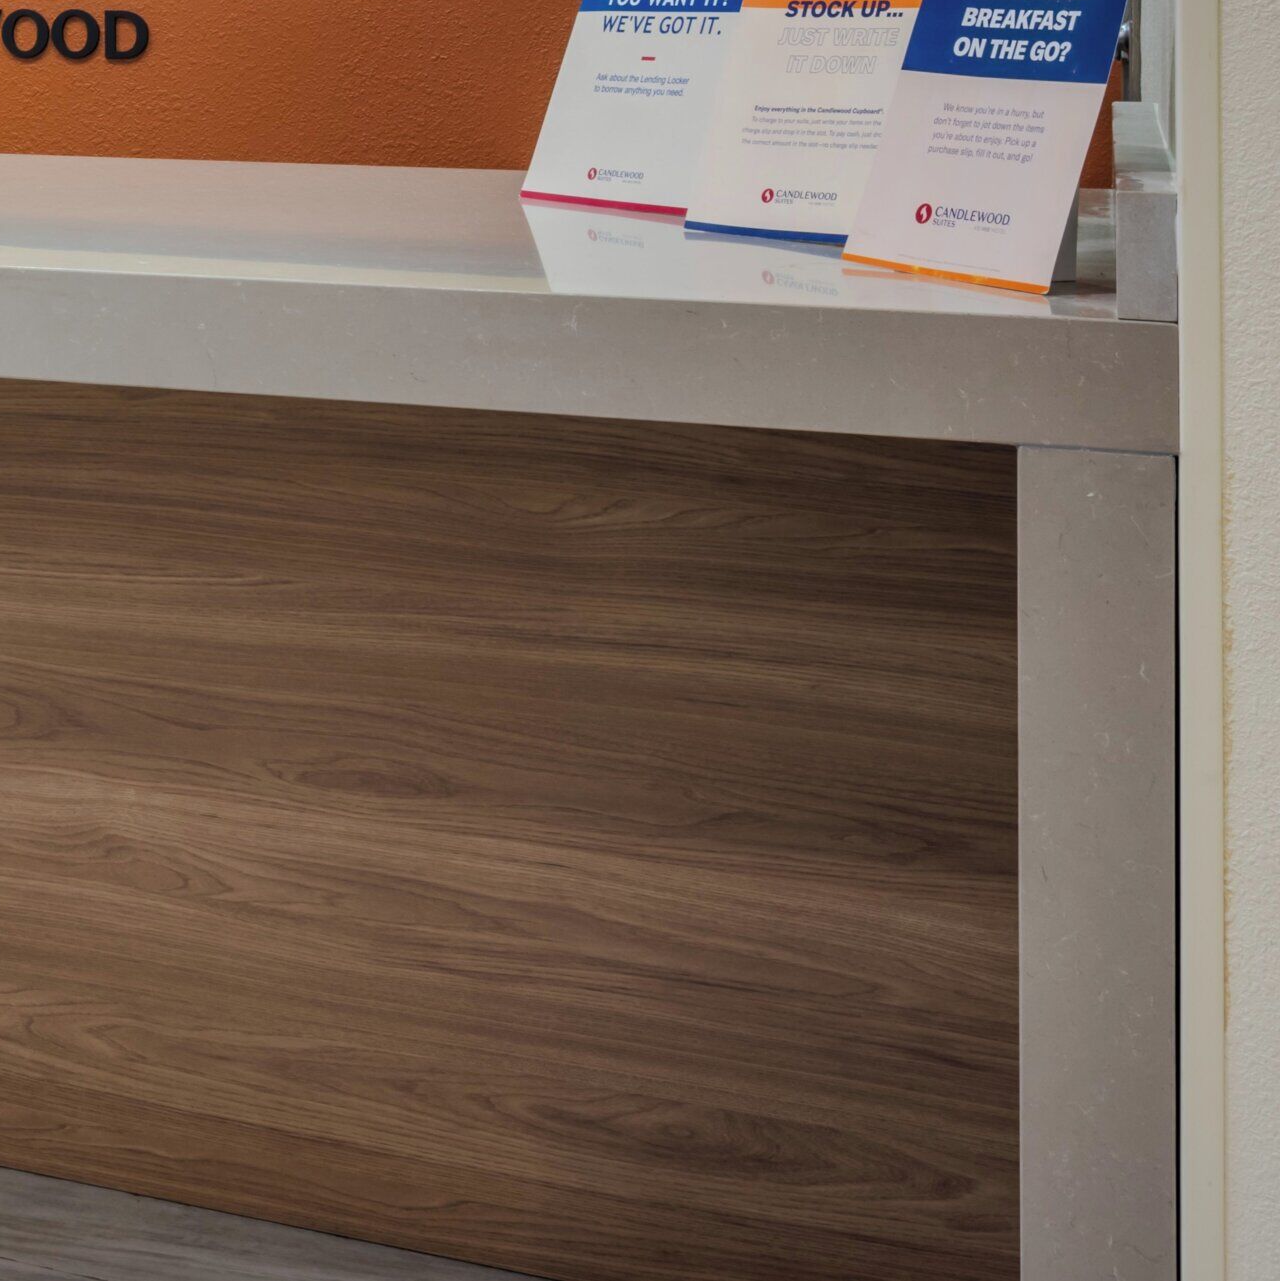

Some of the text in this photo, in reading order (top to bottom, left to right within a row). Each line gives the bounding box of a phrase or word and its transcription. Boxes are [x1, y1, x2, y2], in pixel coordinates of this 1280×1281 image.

[785, 0, 903, 18] STOCK UP...
[603, 16, 722, 35] WE'VE GOT IT.
[961, 7, 1081, 31] BREAKFAST
[777, 28, 900, 47] JUST WRITE
[953, 37, 1072, 62] ON THE GO?
[785, 55, 877, 74] IT DOWN
[609, 73, 629, 82] about
[629, 74, 639, 82] the
[640, 76, 666, 85] Lending
[625, 86, 651, 96] anything
[943, 103, 954, 112] We
[956, 104, 973, 113] know
[974, 105, 995, 115] you're
[1032, 110, 1044, 118] but
[933, 117, 1045, 133] don't forget to jot down the items
[932, 131, 952, 140] you're
[954, 133, 974, 142] about
[1005, 136, 1019, 145] Pick
[1021, 140, 1030, 148] up
[927, 145, 959, 154] purchase
[976, 149, 985, 157] fill
[986, 150, 991, 158] it
[1006, 152, 1020, 161] and
[1021, 154, 1033, 164] go!
[599, 169, 644, 179] CANDLEWOOD
[776, 190, 837, 201] CANDLEWOOD
[932, 218, 955, 228] SUITES
[935, 206, 1011, 225] CANDLEWOOD
